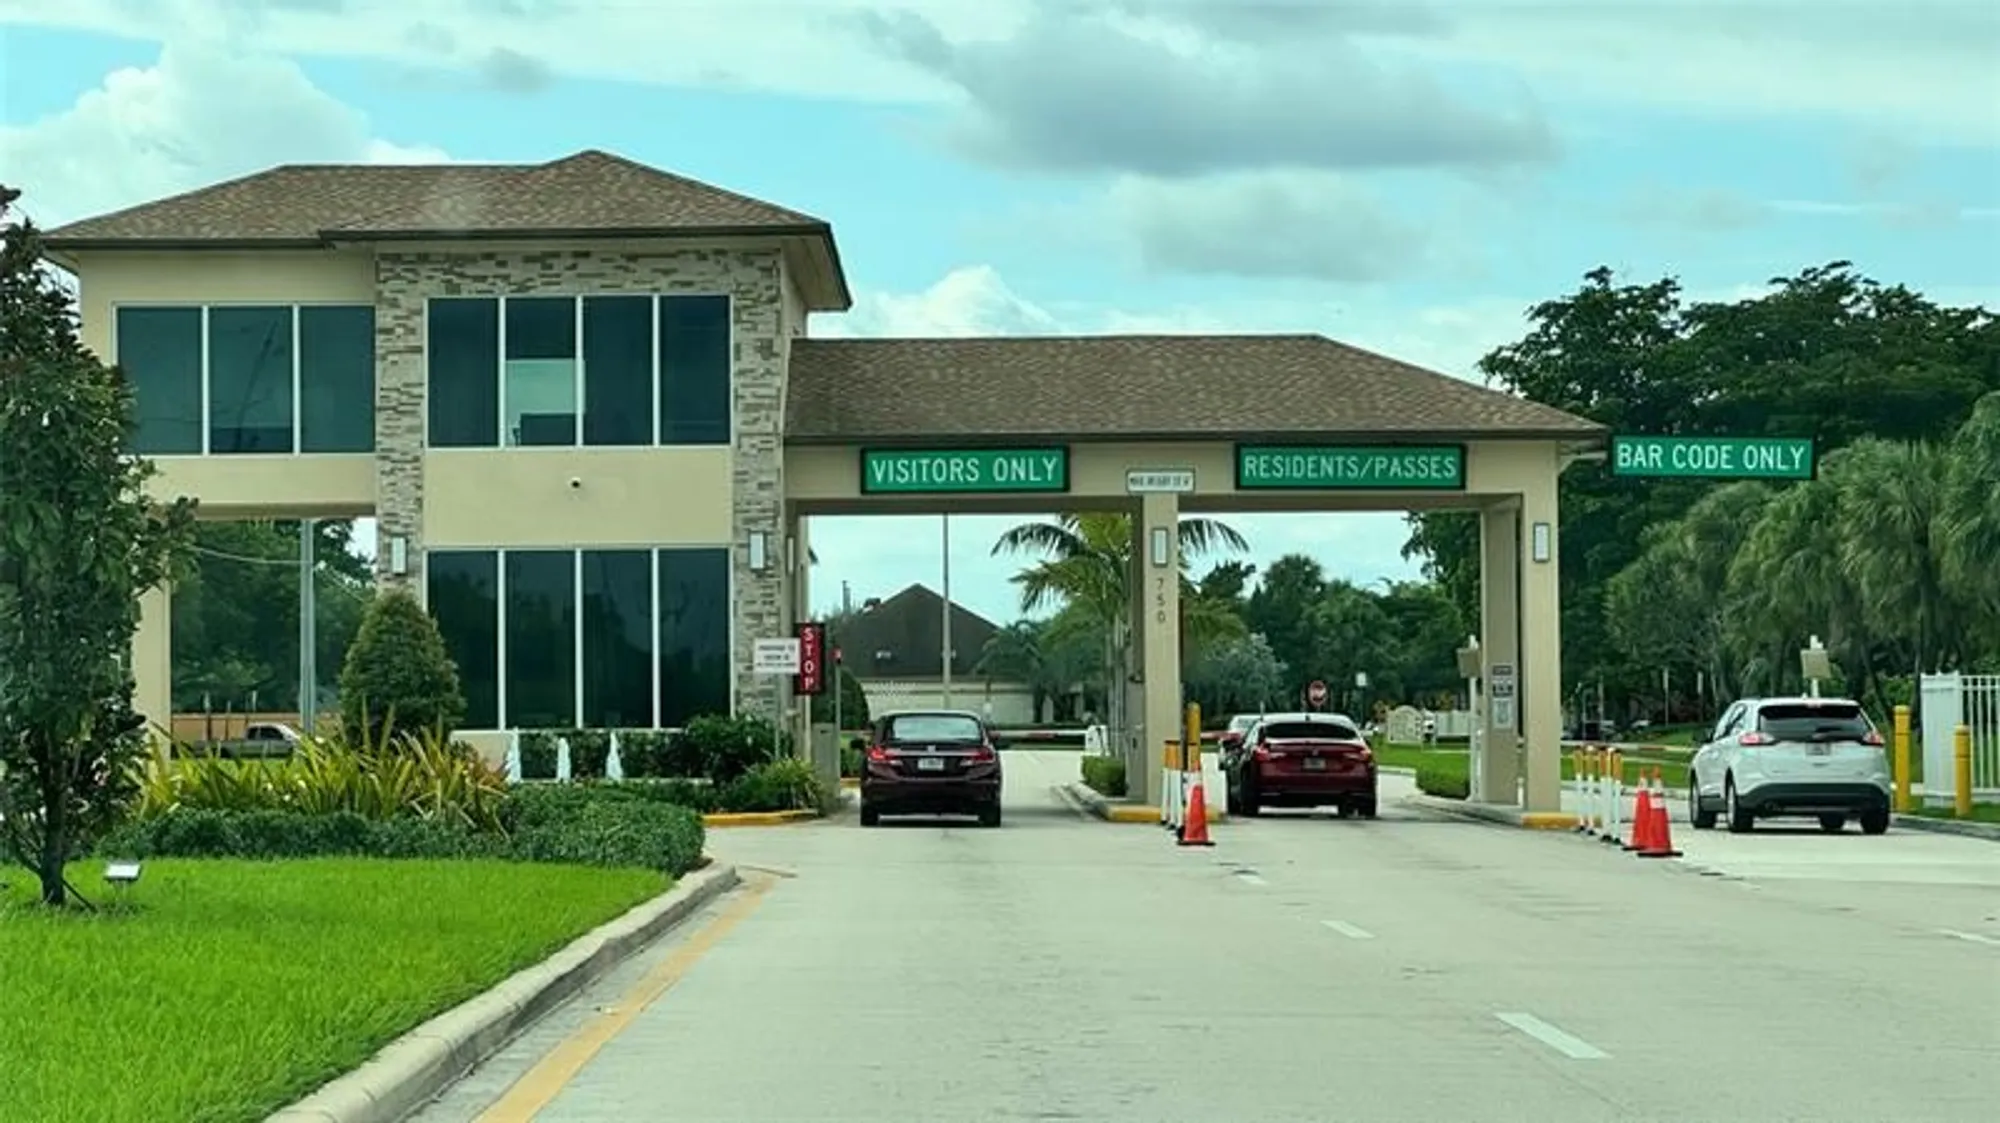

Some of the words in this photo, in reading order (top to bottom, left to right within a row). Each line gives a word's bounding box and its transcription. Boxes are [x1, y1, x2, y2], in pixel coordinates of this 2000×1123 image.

[871, 457, 980, 484] VISITORS
[992, 456, 1057, 483] ONLY
[1244, 455, 1457, 479] RESIDENTS/PASSES
[1617, 443, 1663, 468] BAR
[1671, 444, 1733, 470] CODE
[1742, 445, 1805, 471] ONLY
[803, 626, 814, 690] STOP
